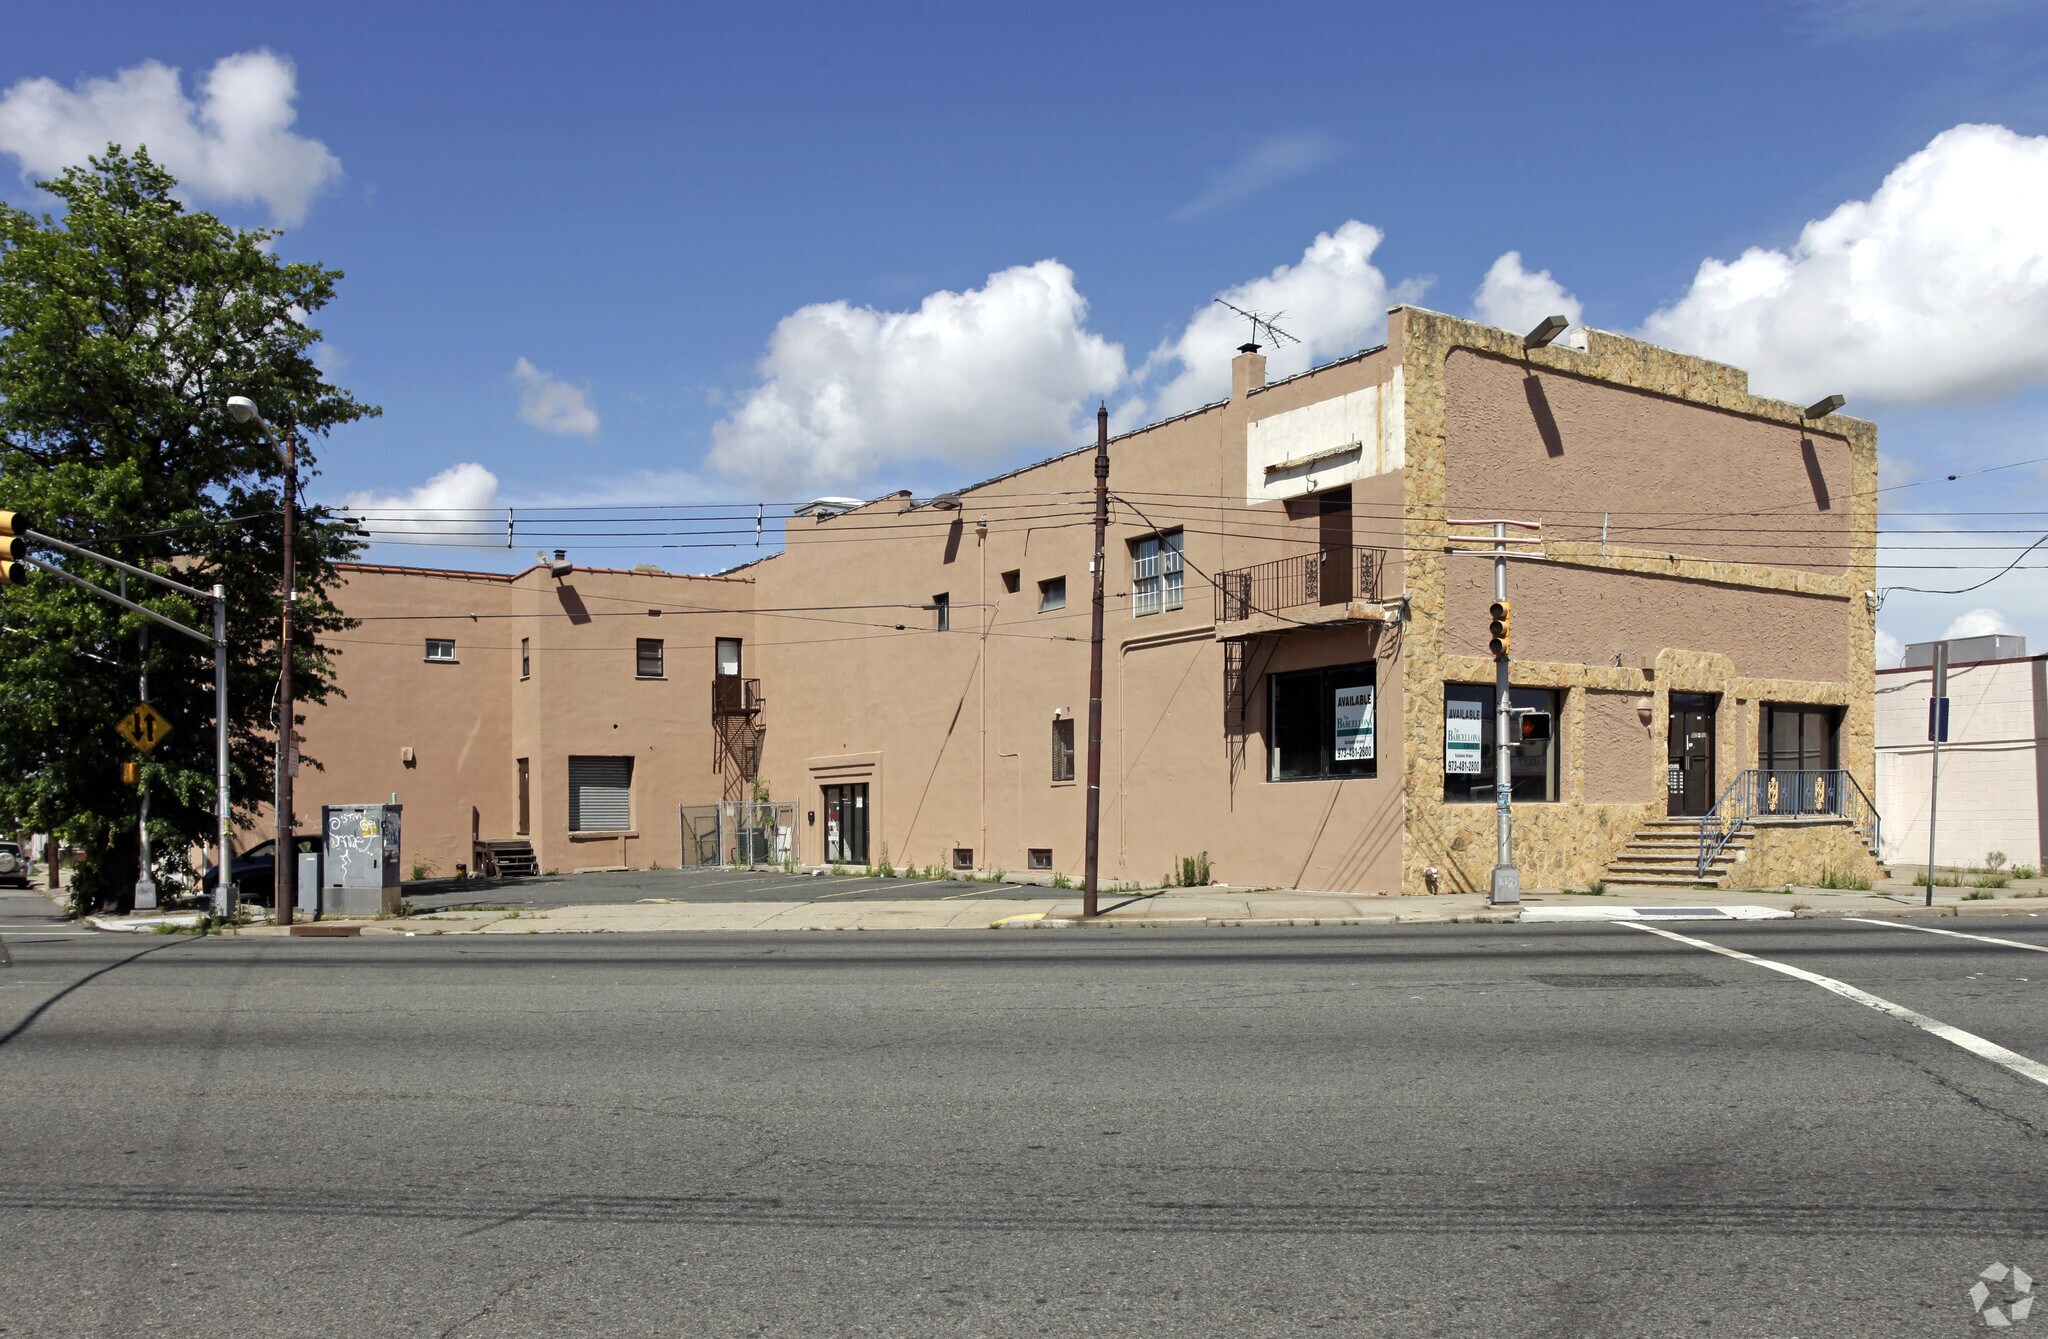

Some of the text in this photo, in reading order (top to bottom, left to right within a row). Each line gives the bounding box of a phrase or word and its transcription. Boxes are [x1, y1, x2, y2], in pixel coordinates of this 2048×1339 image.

[1338, 694, 1371, 707] AVAILABLE
[1448, 709, 1480, 720] AVAILABLE
[1448, 761, 1479, 771] 973-481-2800
